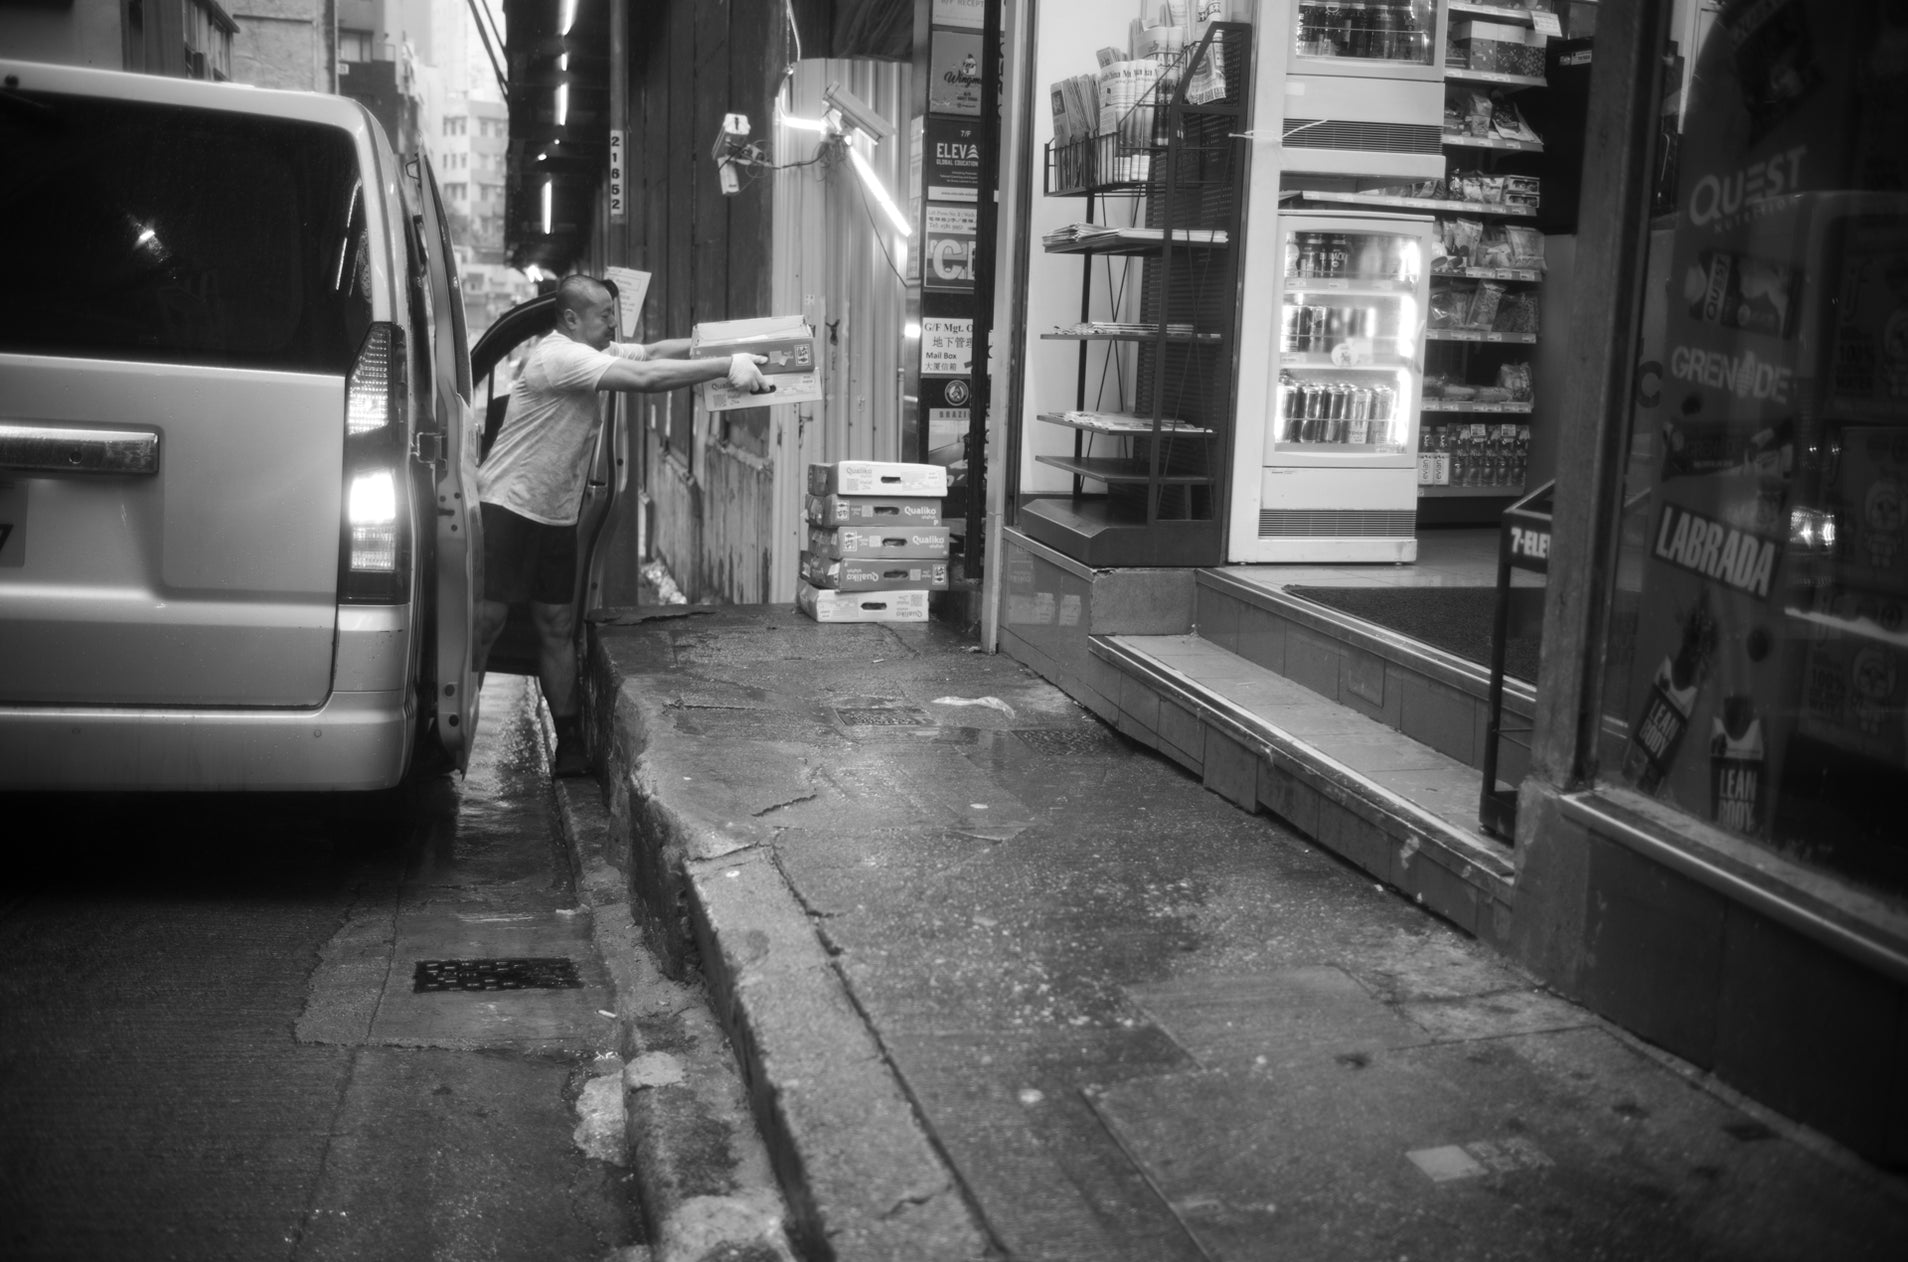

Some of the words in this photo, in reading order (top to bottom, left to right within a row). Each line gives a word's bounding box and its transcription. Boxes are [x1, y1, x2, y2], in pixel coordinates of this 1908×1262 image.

[960, 130, 972, 138] 7/F
[936, 158, 953, 166] GLOBAL
[611, 135, 620, 212] 21652
[1689, 144, 1807, 226] QUEST
[924, 322, 942, 332] G/F
[943, 323, 964, 334] Mgt.
[925, 351, 942, 360] Mail
[943, 352, 957, 360] Box
[1422, 459, 1430, 480] evian
[904, 505, 937, 516] Qualiko
[912, 535, 945, 545] Qualiko
[1656, 506, 1775, 598] LABRADA
[846, 571, 879, 582] Qualiko
[1649, 698, 1680, 742] LEAN
[1720, 768, 1757, 800] LEAN
